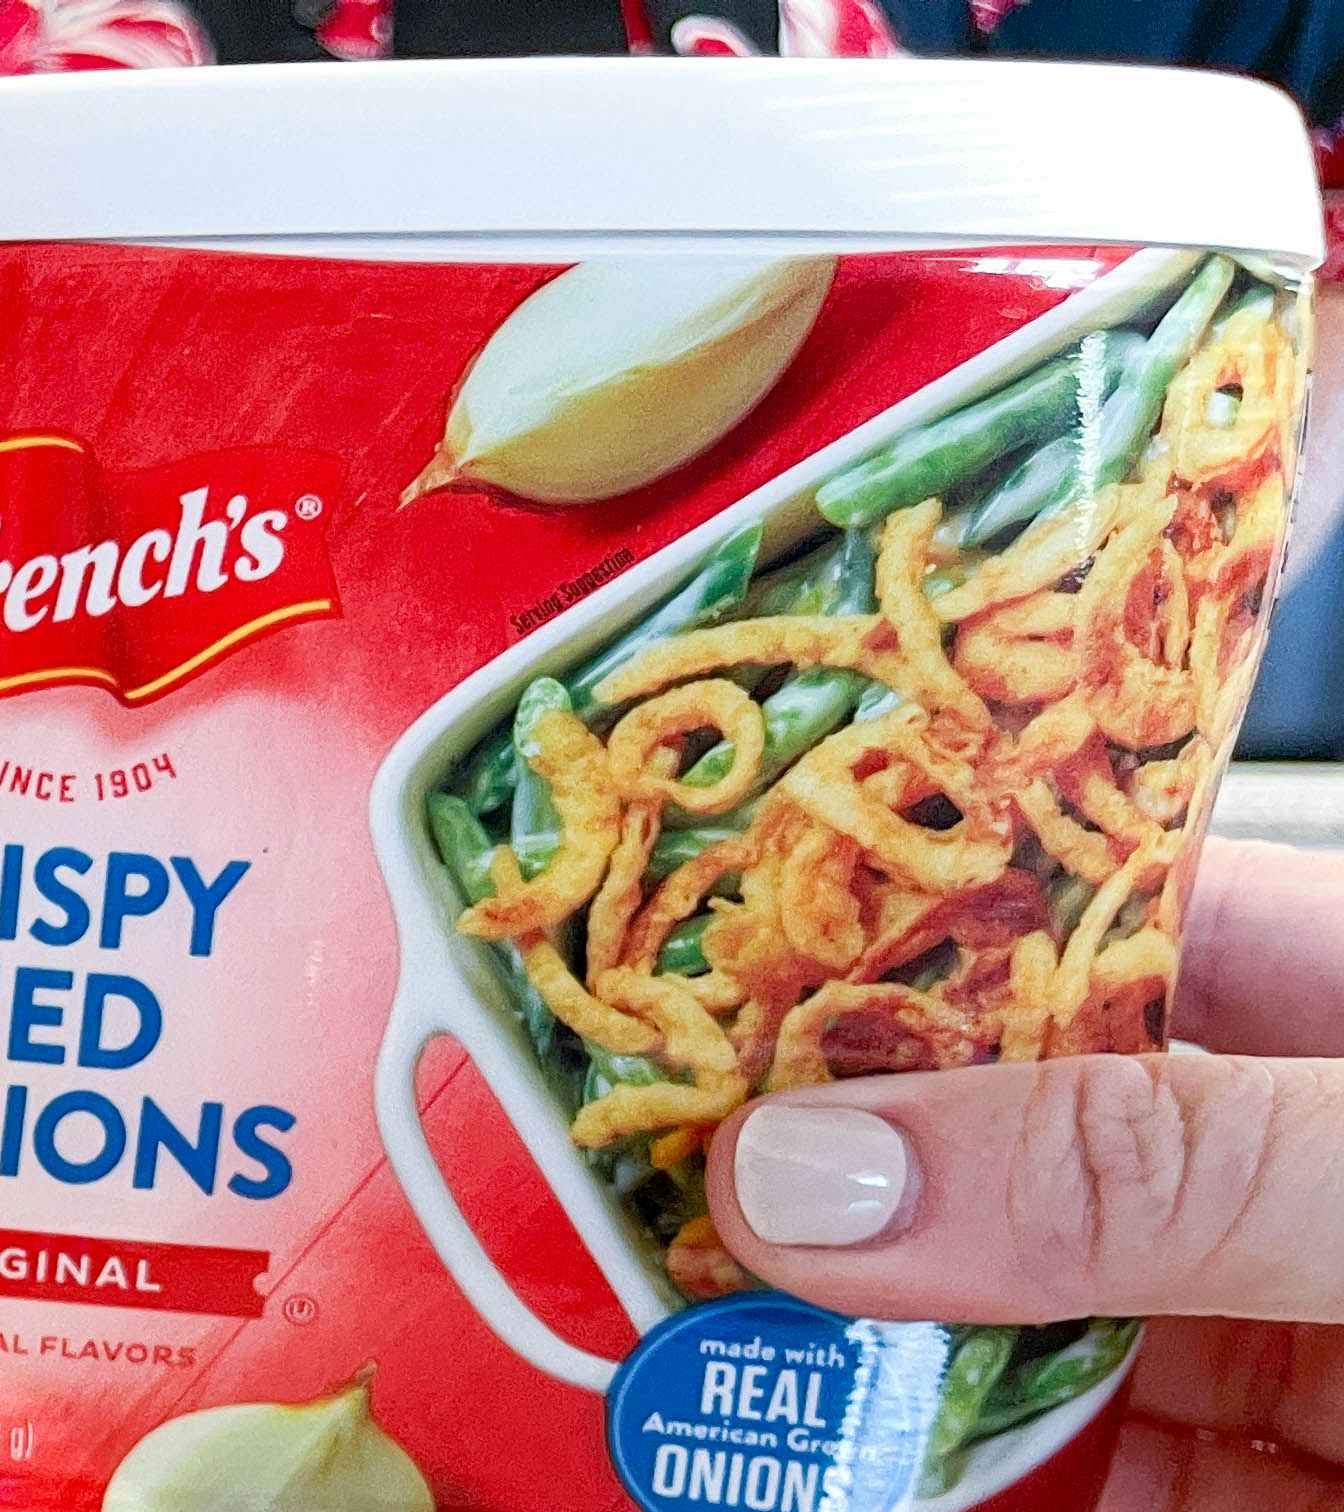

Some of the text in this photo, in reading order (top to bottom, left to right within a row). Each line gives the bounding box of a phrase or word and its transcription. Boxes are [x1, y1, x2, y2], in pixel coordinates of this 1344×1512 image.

[510, 547, 635, 635] Serving Suggestion
[95, 753, 176, 801] 1904
[40, 1336, 197, 1367] FLAVORS
[700, 1336, 845, 1369] made with
[701, 1361, 826, 1428] REAL
[10, 1420, 34, 1461] g)
[642, 1411, 777, 1448] American
